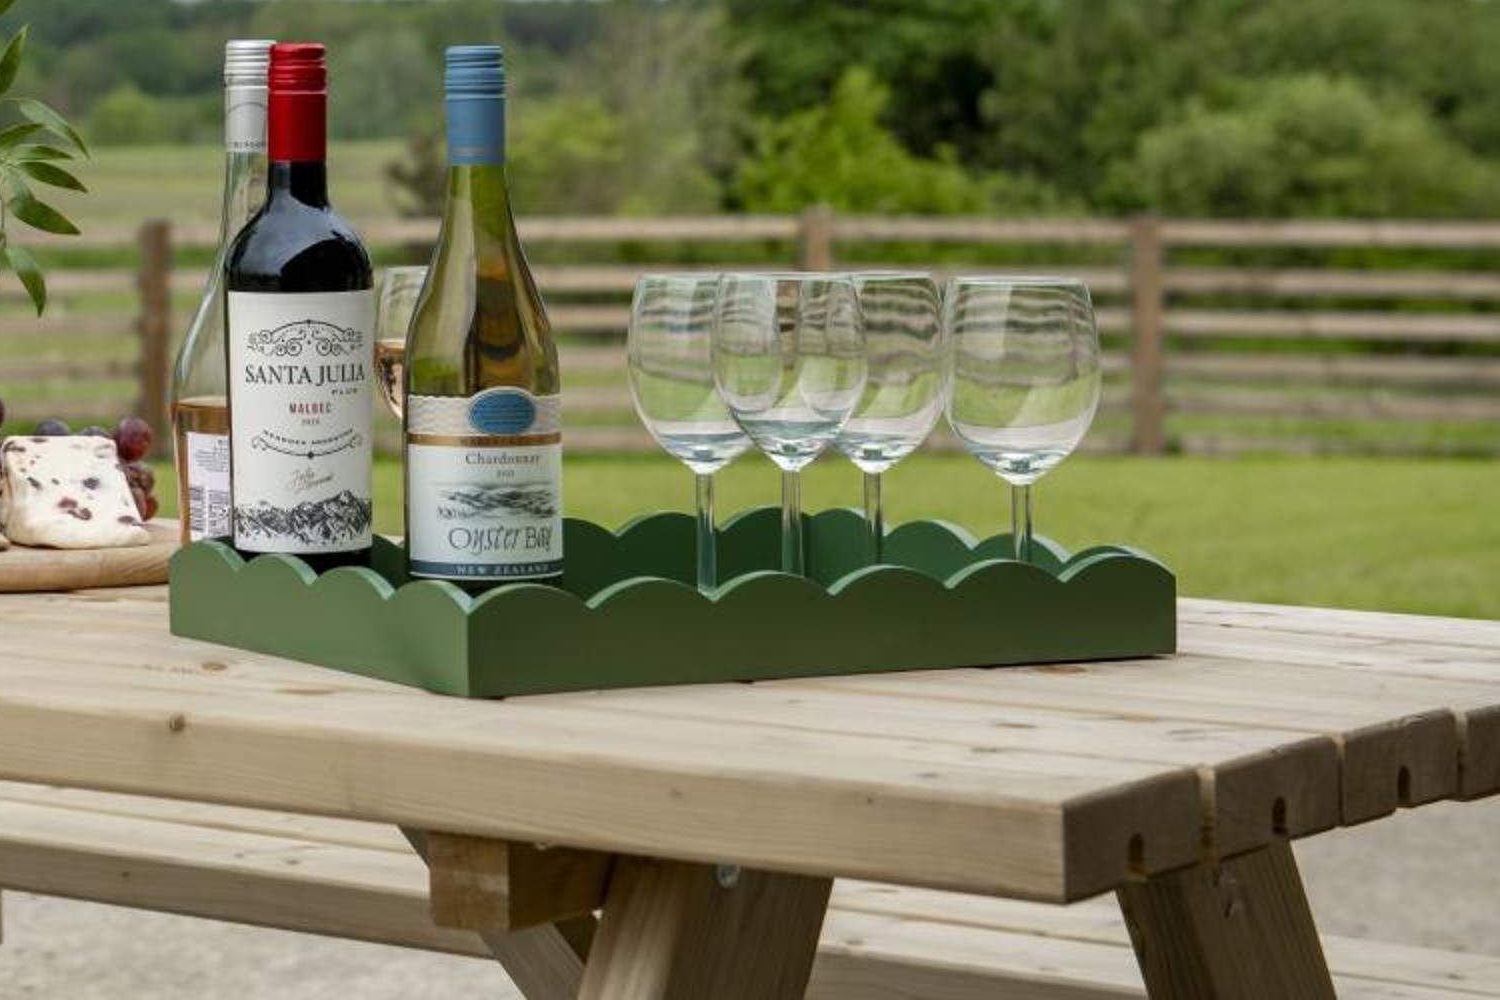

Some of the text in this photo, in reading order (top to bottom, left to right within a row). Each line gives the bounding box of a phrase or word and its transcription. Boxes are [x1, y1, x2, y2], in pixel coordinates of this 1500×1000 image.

[245, 363, 365, 386] SANTA JULIA
[289, 402, 332, 414] MALBEC
[465, 452, 539, 467] Chardonnay
